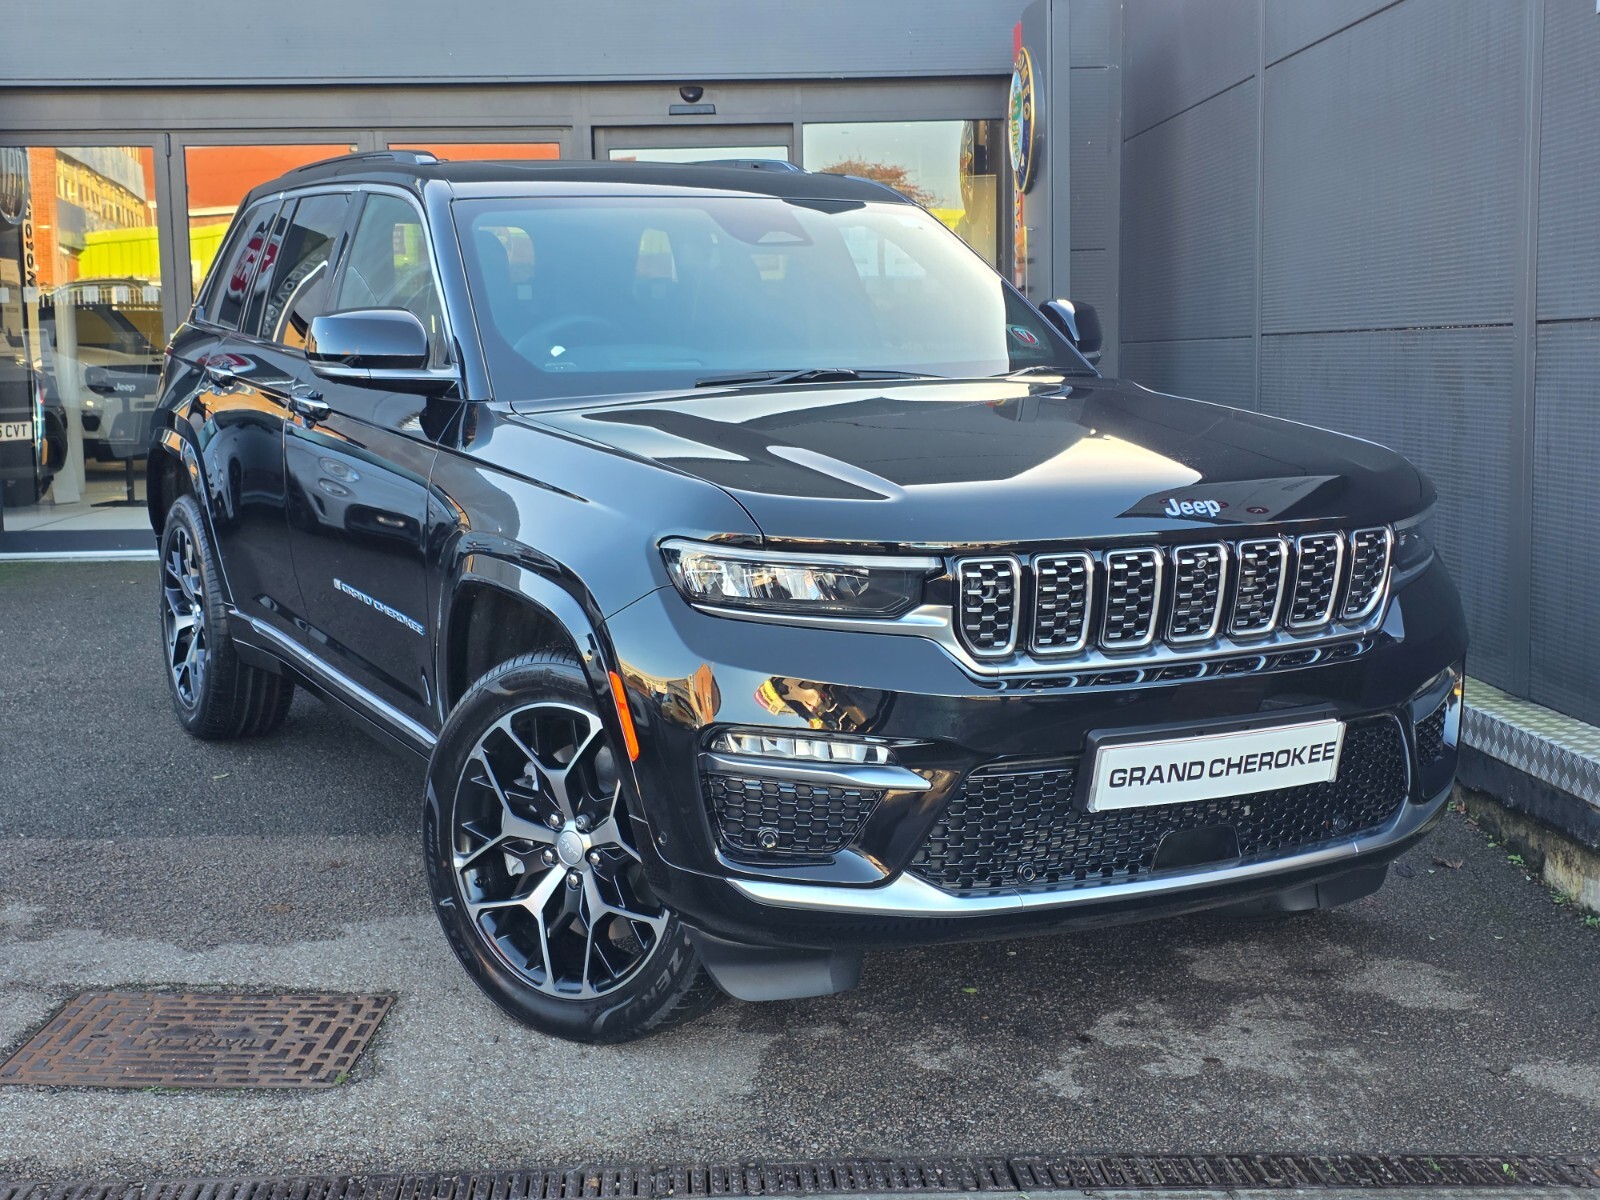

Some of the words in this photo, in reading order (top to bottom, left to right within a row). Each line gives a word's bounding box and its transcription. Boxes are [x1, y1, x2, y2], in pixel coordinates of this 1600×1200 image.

[113, 382, 136, 392] Jeep
[5, 423, 28, 438] CVT
[1164, 498, 1221, 518] Jeep
[1108, 760, 1205, 788] GRAND
[1208, 741, 1337, 779] CHEROKEE
